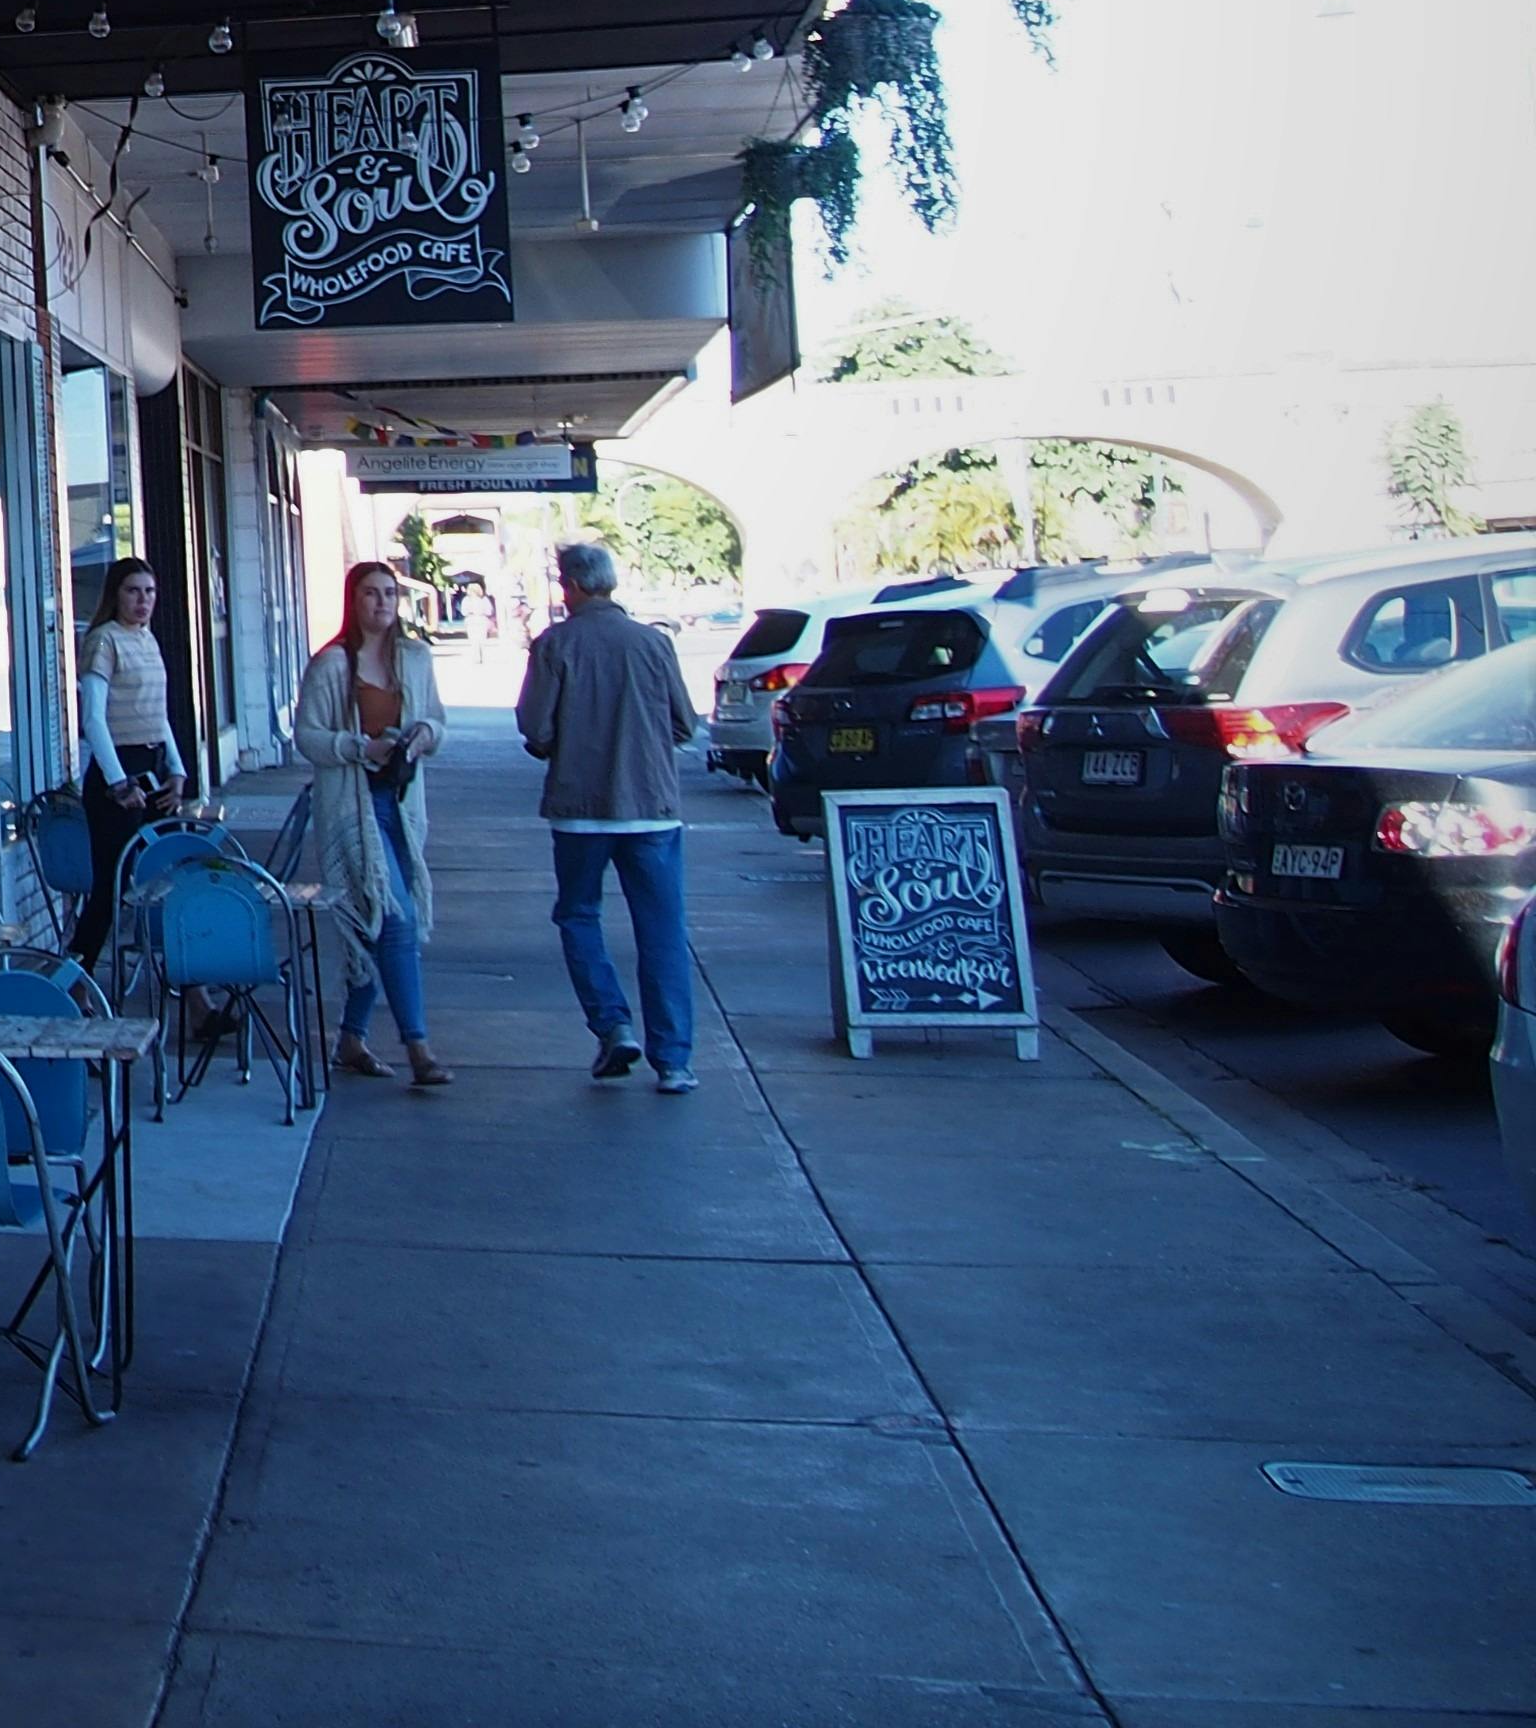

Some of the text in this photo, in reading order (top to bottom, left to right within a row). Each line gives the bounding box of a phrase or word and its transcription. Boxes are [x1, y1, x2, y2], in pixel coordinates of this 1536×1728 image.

[271, 80, 458, 199] HEART
[256, 111, 495, 260] Soul
[355, 154, 387, 184] &
[293, 240, 473, 298] WHOLEFOOD CAFE
[357, 453, 427, 472] Angelite
[428, 453, 486, 474] Energy
[419, 479, 537, 491] FRESH POULTRY
[855, 823, 986, 878] HEART
[847, 842, 1005, 927] Soul
[863, 915, 993, 950] WHOLEFOOD CAFE
